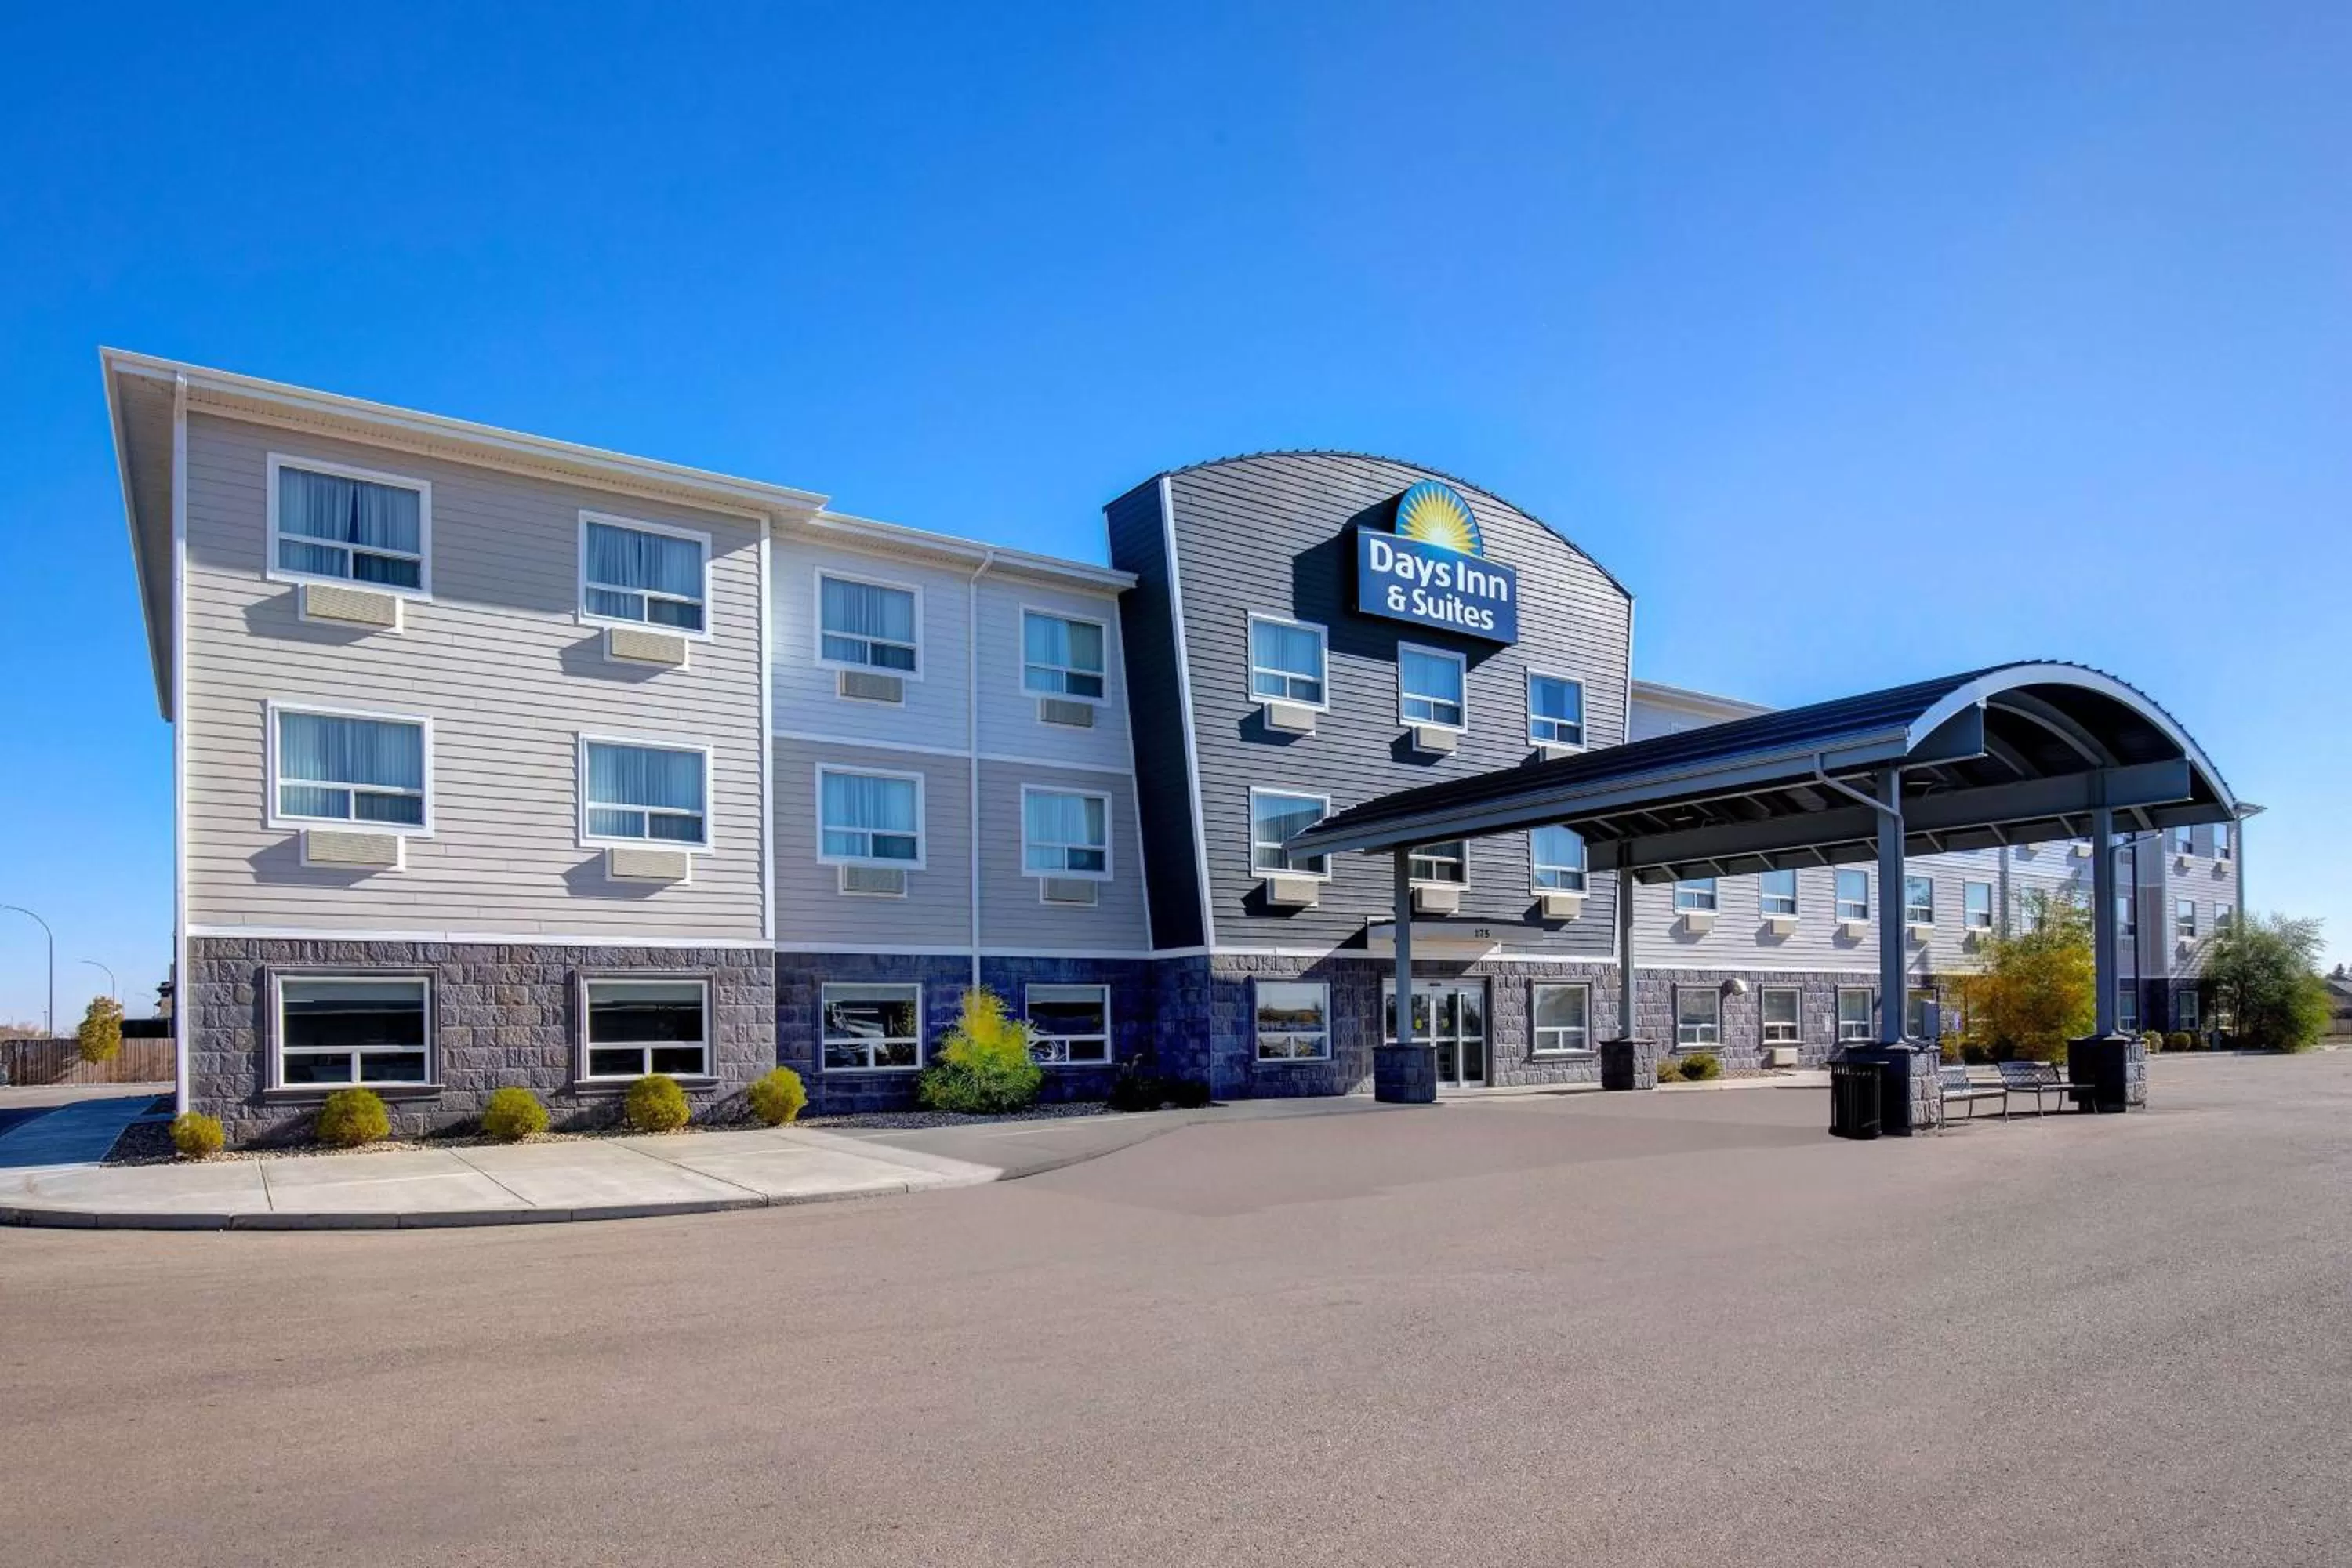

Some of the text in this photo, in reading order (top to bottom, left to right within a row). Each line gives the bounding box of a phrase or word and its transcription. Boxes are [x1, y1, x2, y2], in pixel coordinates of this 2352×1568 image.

[1370, 539, 1508, 601] Days Inn
[1387, 585, 1494, 630] & Suites
